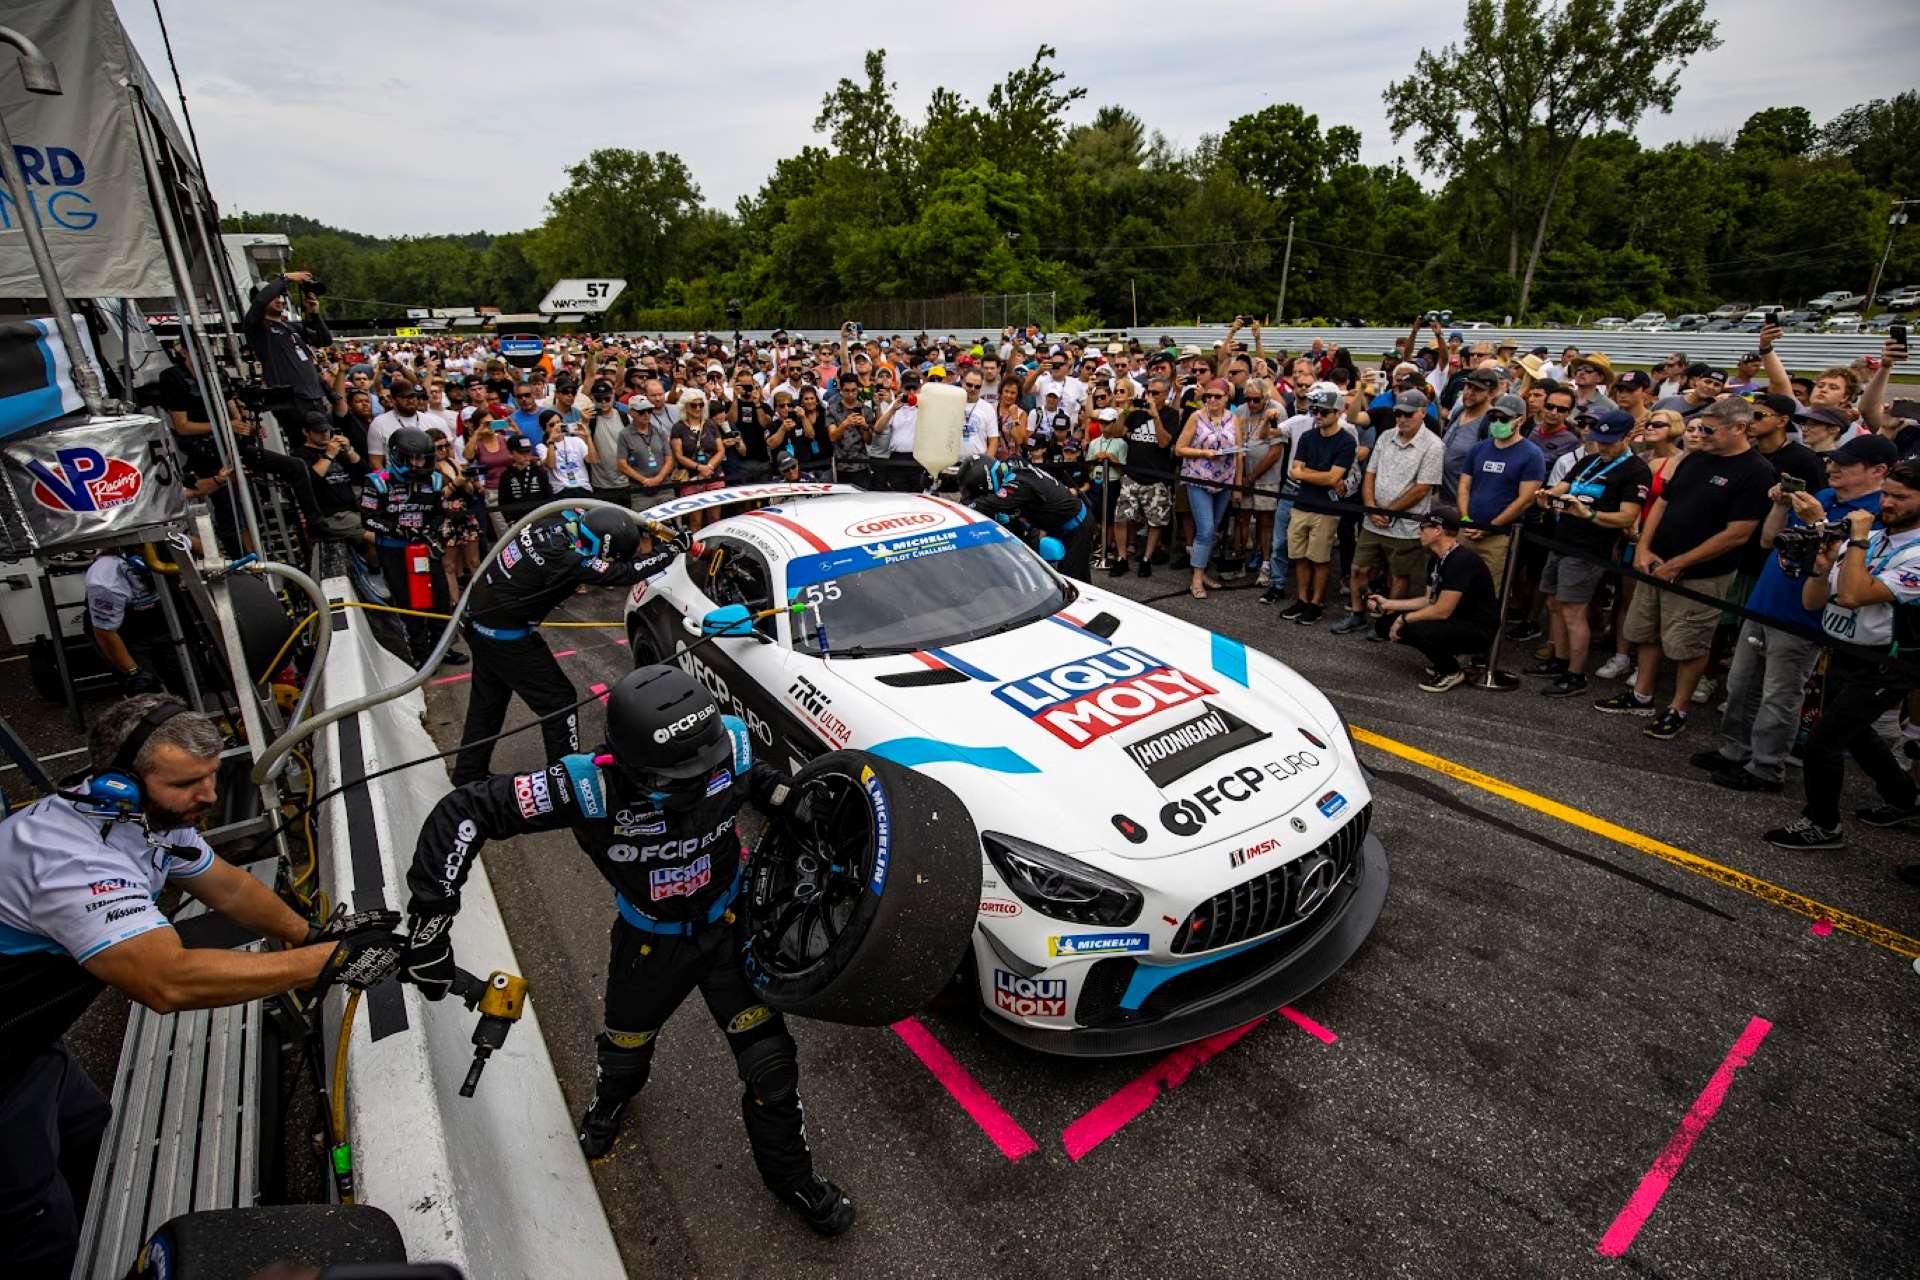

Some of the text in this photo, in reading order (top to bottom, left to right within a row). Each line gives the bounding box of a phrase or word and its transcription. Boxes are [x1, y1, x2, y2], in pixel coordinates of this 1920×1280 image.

[0, 144, 85, 187] RD
[587, 283, 609, 297] 57
[25, 447, 107, 511] VP
[92, 470, 140, 500] Racing
[643, 483, 833, 520] LIQUI MOLY
[857, 514, 935, 535] CORTECO
[885, 544, 957, 565] PILOT CHALLENGE
[892, 531, 957, 550] MICHELIN
[806, 580, 842, 605] 55
[1001, 649, 1162, 712] LIQUI
[692, 652, 773, 747] FCP EURO
[788, 675, 832, 717] TRW
[1044, 668, 1204, 743] MOLY
[668, 713, 698, 737] FCP
[819, 711, 852, 744] ULTRA
[516, 776, 538, 818] MOLY
[1193, 751, 1320, 816] FCP EURO
[640, 838, 699, 862] FCP
[872, 790, 889, 884] MICHELIN
[1246, 838, 1282, 860] IMSA
[445, 838, 470, 880] FCP
[978, 902, 1016, 914] ORTECO
[1078, 937, 1141, 950] MICHELIN
[998, 971, 1064, 998] LIQUI
[997, 991, 1066, 1015] MOLY
